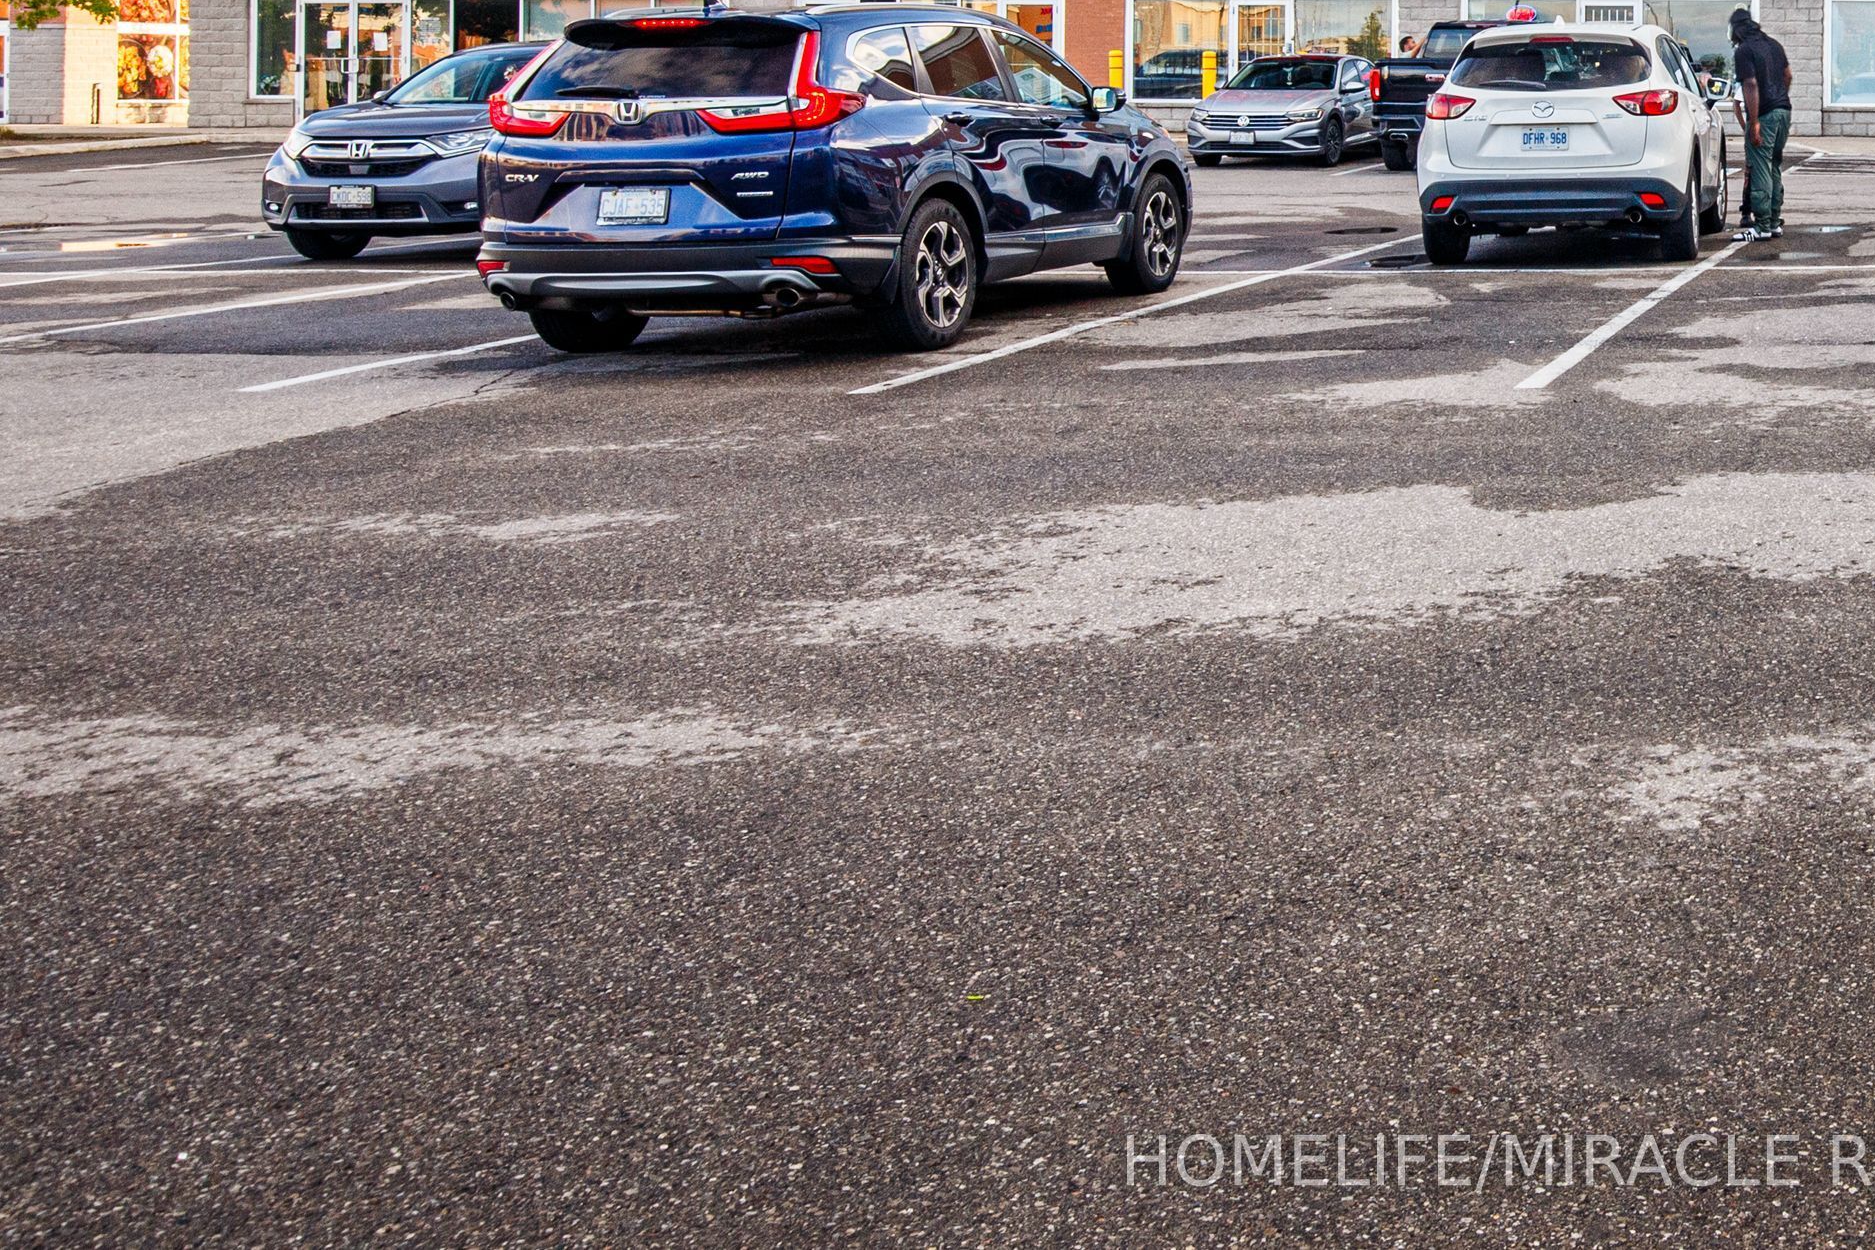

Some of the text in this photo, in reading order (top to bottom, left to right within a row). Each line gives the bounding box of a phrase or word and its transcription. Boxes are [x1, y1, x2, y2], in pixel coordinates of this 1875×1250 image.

[1550, 132, 1568, 145] 968
[505, 173, 539, 183] CR-V
[730, 171, 770, 180] AWD
[601, 198, 665, 216] CJAF 535
